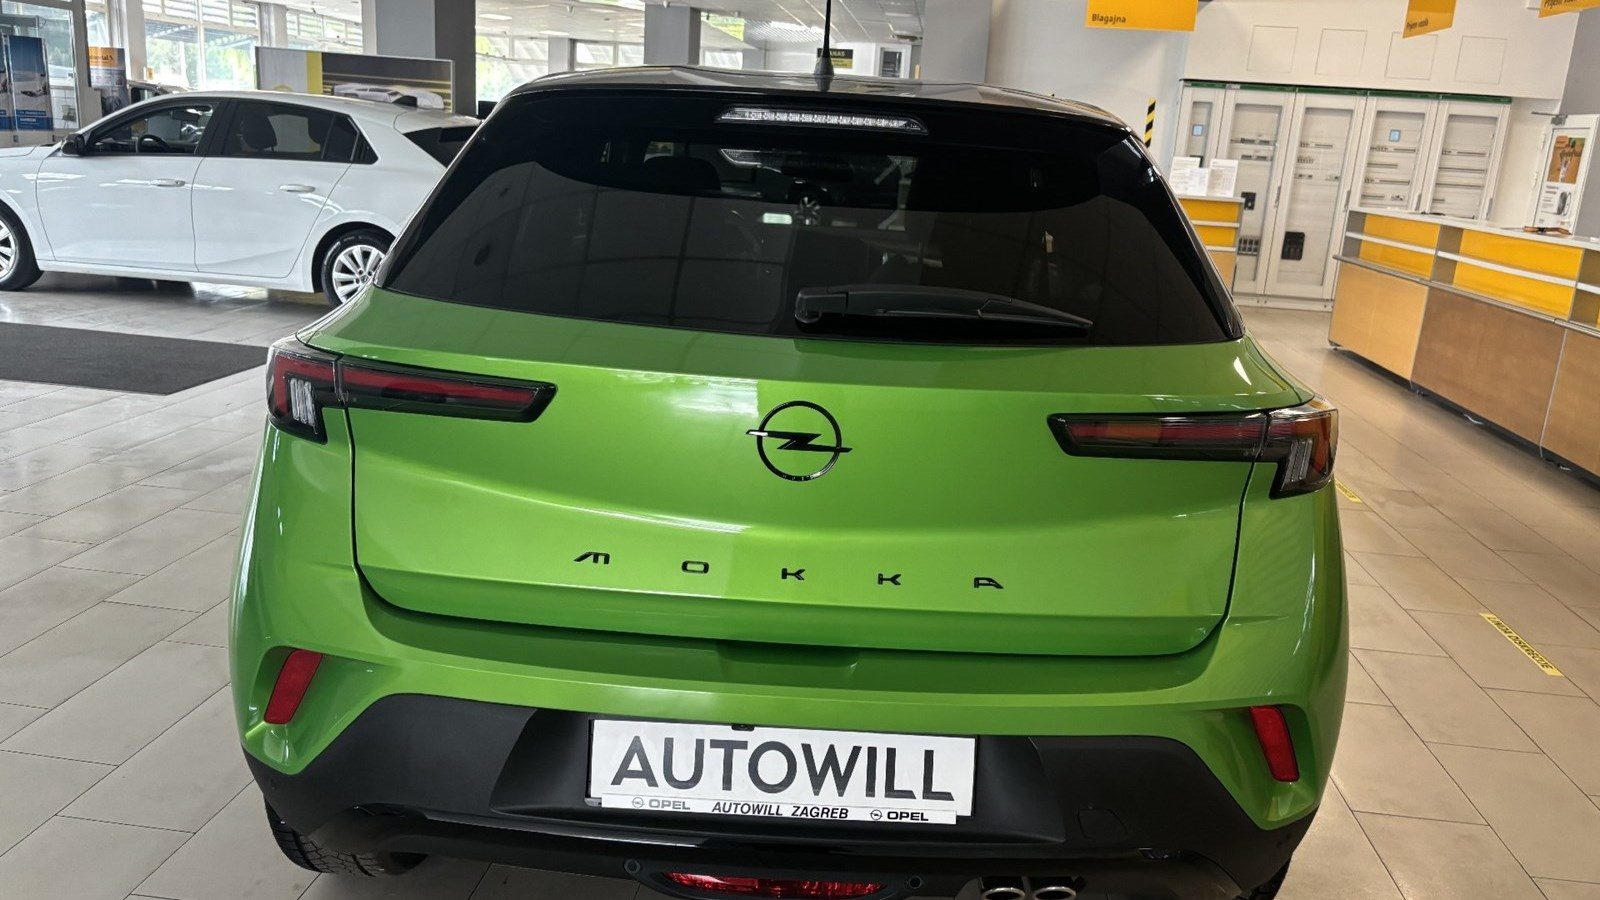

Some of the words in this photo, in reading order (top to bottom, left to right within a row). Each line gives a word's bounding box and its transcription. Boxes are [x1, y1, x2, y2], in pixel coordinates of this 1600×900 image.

[1091, 13, 1127, 25] Blagajna
[574, 551, 1004, 590] MOKKA
[610, 735, 955, 802] AUTOWILL
[648, 798, 691, 811] OPEL
[711, 801, 783, 817] AUTOWILL
[791, 805, 849, 819] ZAGREB
[887, 811, 929, 822] OPEL
